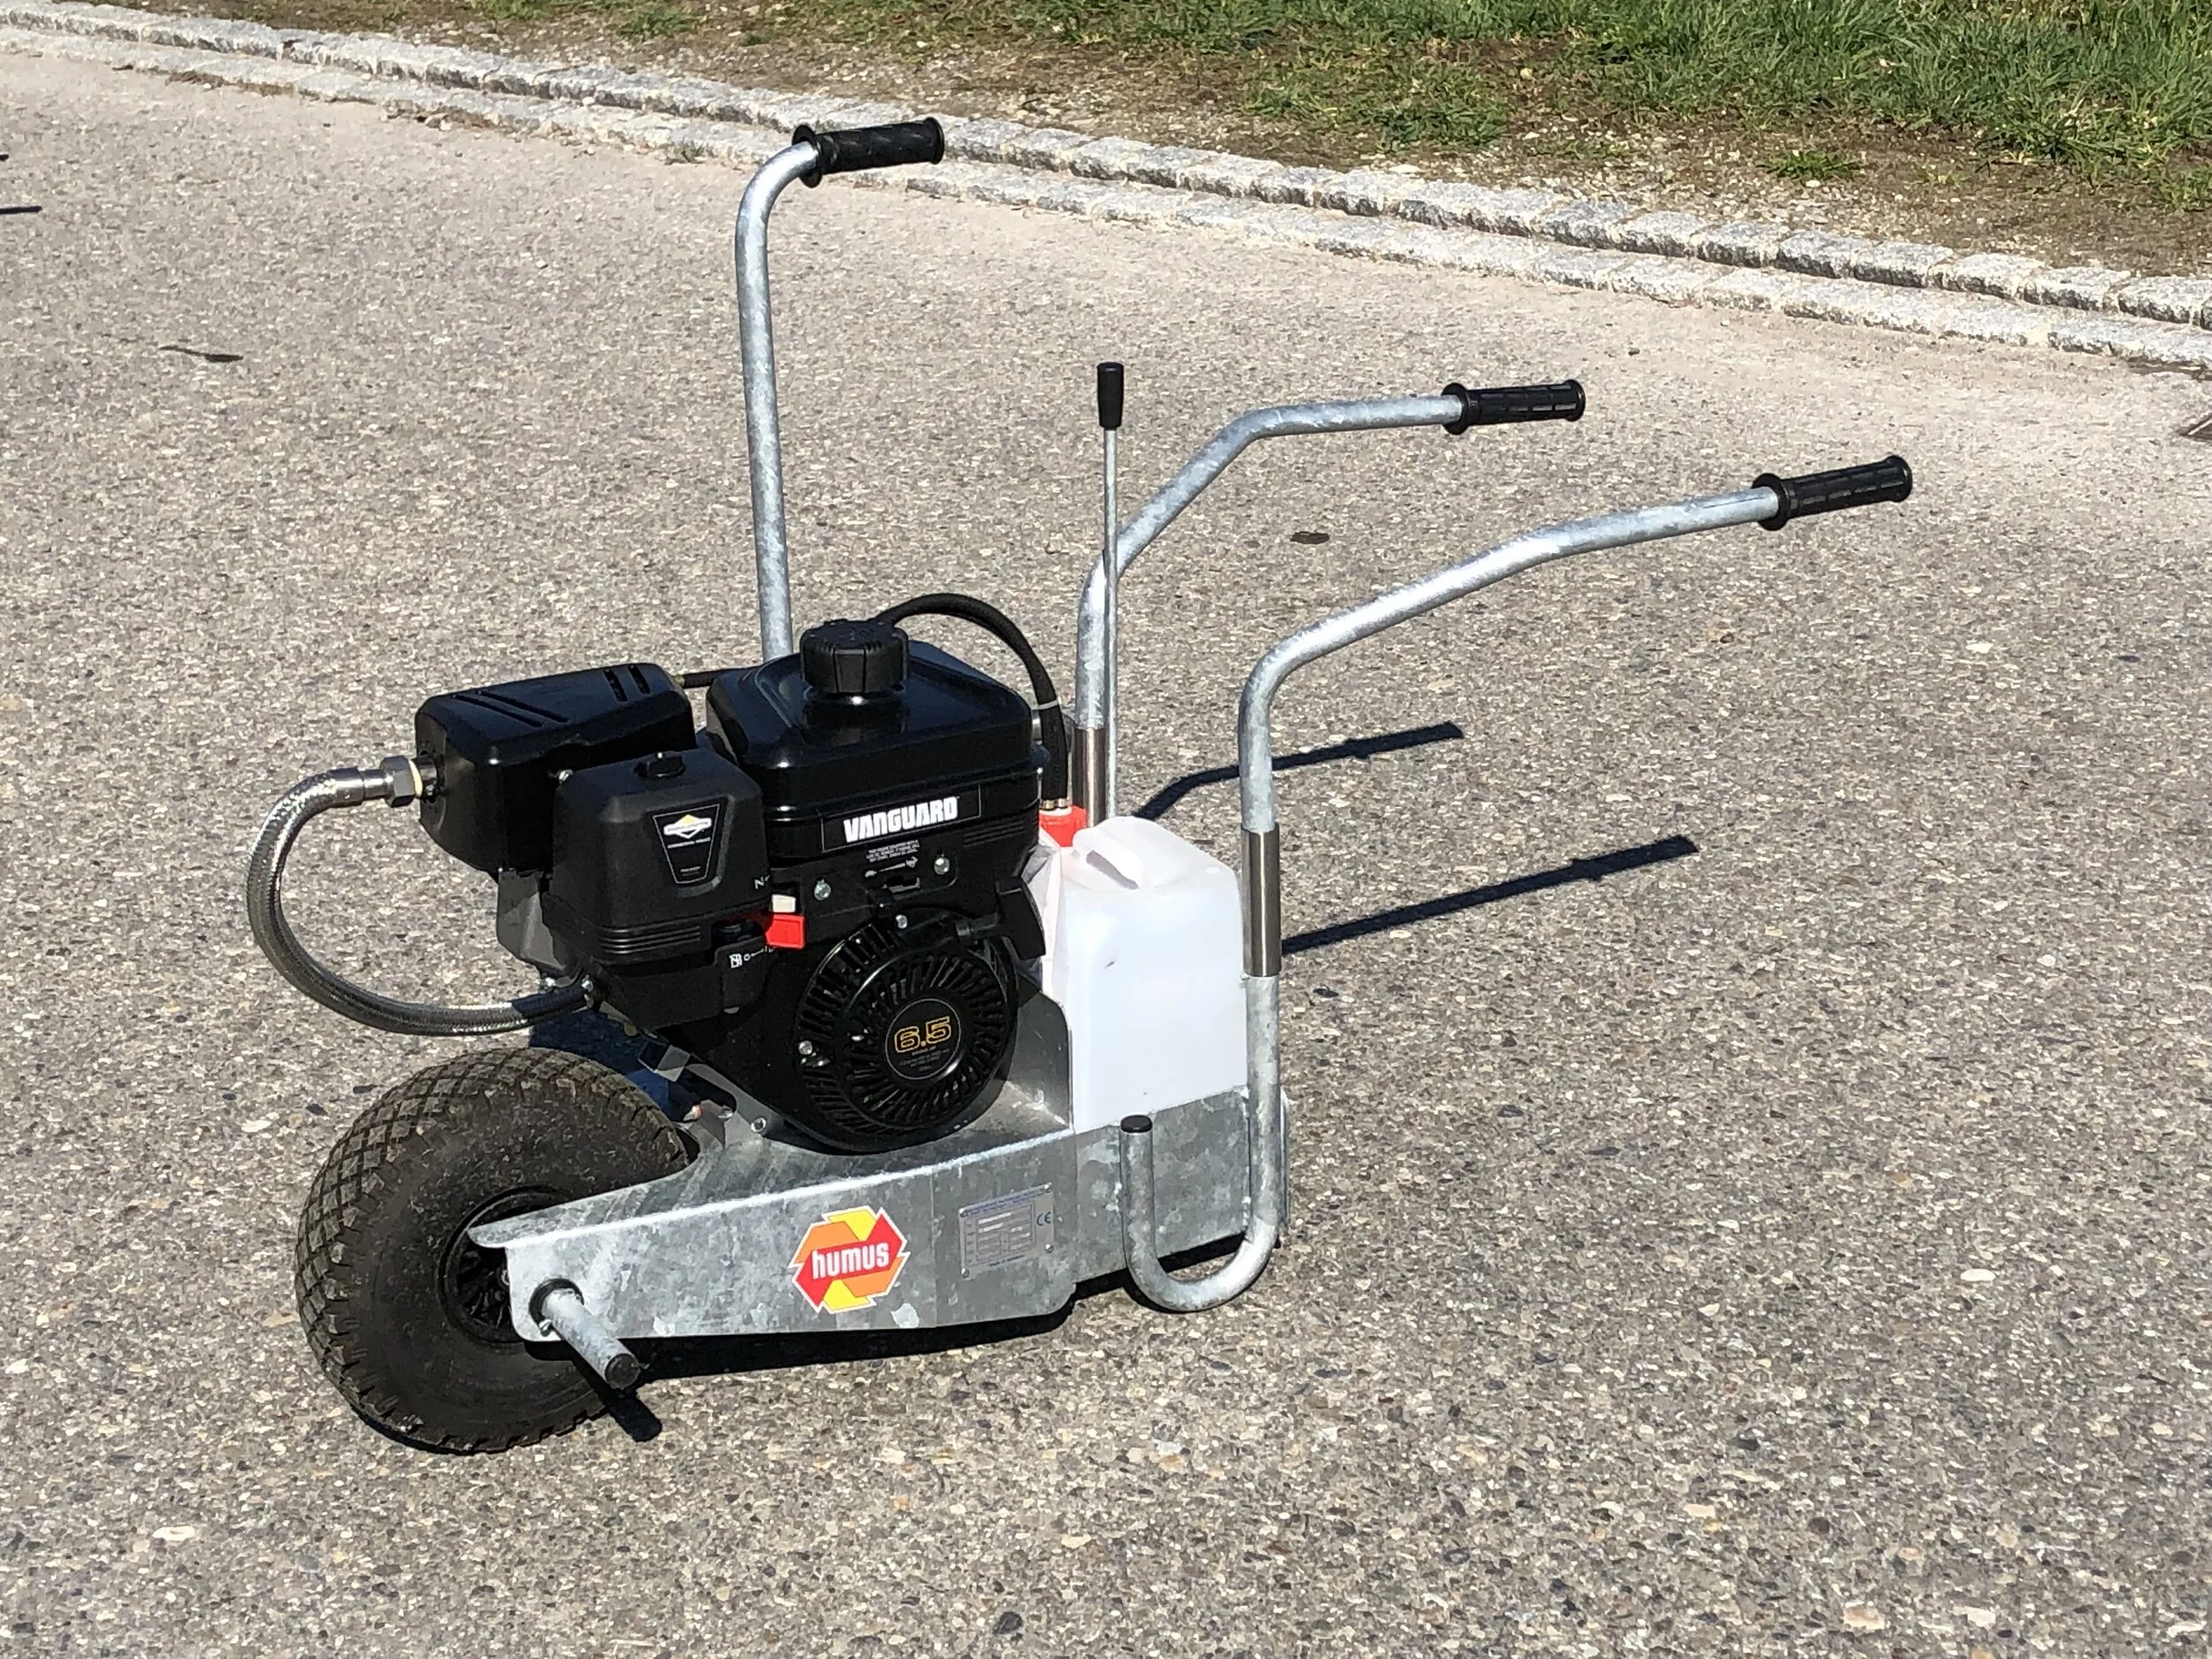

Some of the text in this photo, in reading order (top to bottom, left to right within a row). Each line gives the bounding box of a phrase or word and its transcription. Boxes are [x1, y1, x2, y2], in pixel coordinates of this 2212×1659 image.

[843, 796, 958, 842] VANGUARD
[895, 1016, 952, 1053] 6.5
[1036, 1211, 1052, 1226] CE
[812, 1242, 890, 1280] humus
